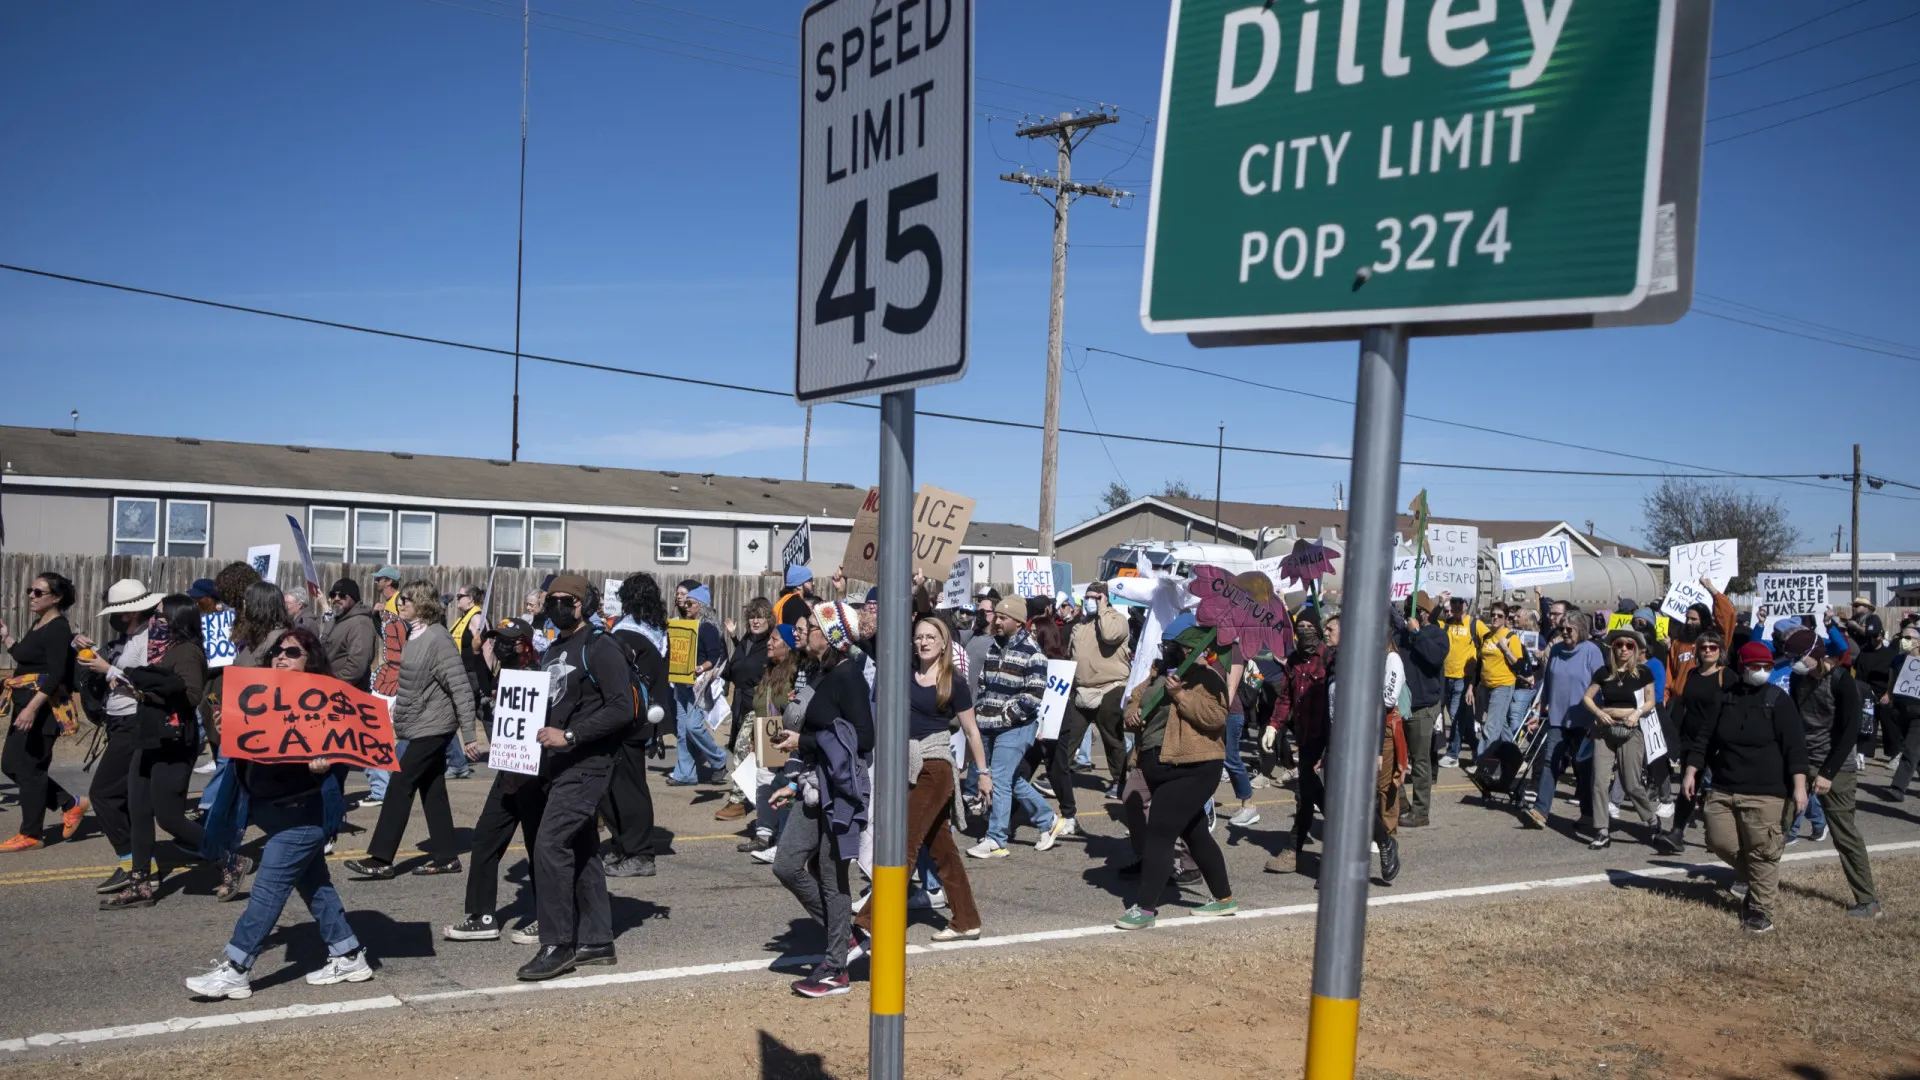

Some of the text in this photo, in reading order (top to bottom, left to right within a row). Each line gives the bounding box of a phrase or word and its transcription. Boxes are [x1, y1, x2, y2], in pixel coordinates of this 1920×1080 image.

[815, 0, 951, 102] SPEED
[1214, 0, 1574, 108] Dilley
[827, 79, 934, 184] LIMIT
[1238, 104, 1535, 196] CITY LIMIT
[1239, 207, 1512, 283] POP 3274
[815, 172, 943, 345] 45
[918, 496, 964, 531] ICE
[783, 523, 808, 565] FREEDOM
[1432, 529, 1468, 544] ICE
[1287, 551, 1325, 568] FAMILIA
[1430, 554, 1477, 569] TRUMP'S
[1501, 541, 1569, 570] LIBERTAD!
[1677, 542, 1727, 564] FUCK
[1026, 558, 1038, 571] NO
[1393, 559, 1410, 571] WE
[1690, 558, 1722, 577] ICE
[1017, 571, 1051, 585] SECRET
[1427, 571, 1476, 585] GESTAPO
[1763, 575, 1824, 590] REMEMBER
[1018, 585, 1055, 598] POLICE
[1675, 582, 1705, 601] LOVE
[1211, 577, 1285, 634] CULTURA
[497, 717, 526, 740] ICE
[491, 758, 520, 769] STOLEN
